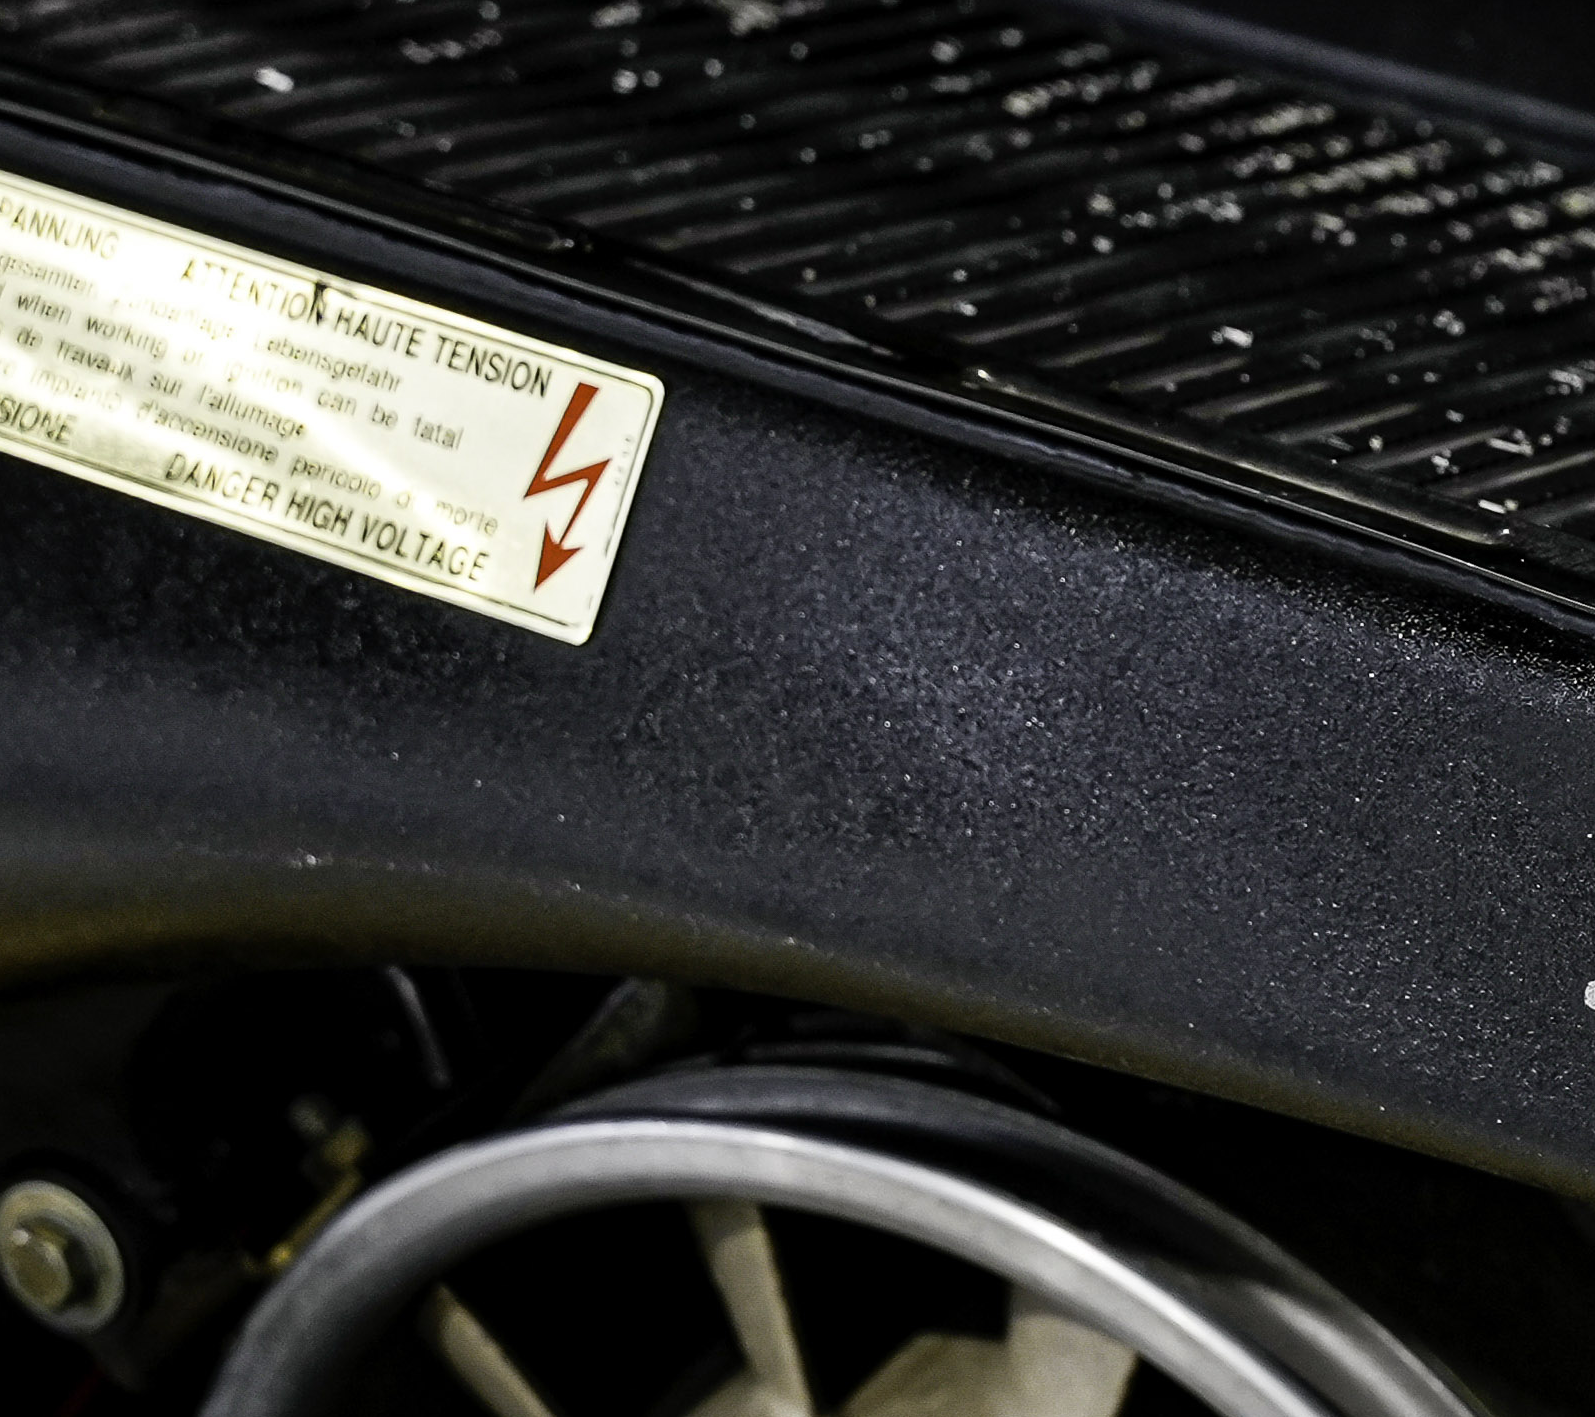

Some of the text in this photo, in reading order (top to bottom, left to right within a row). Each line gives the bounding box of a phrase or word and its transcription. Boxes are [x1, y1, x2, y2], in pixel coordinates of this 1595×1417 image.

[178, 255, 554, 399] ATTENTION HAUTE TENSION
[315, 388, 359, 418] can
[368, 402, 402, 432] be
[163, 449, 491, 586] DANGER HIGH VOLTAGE
